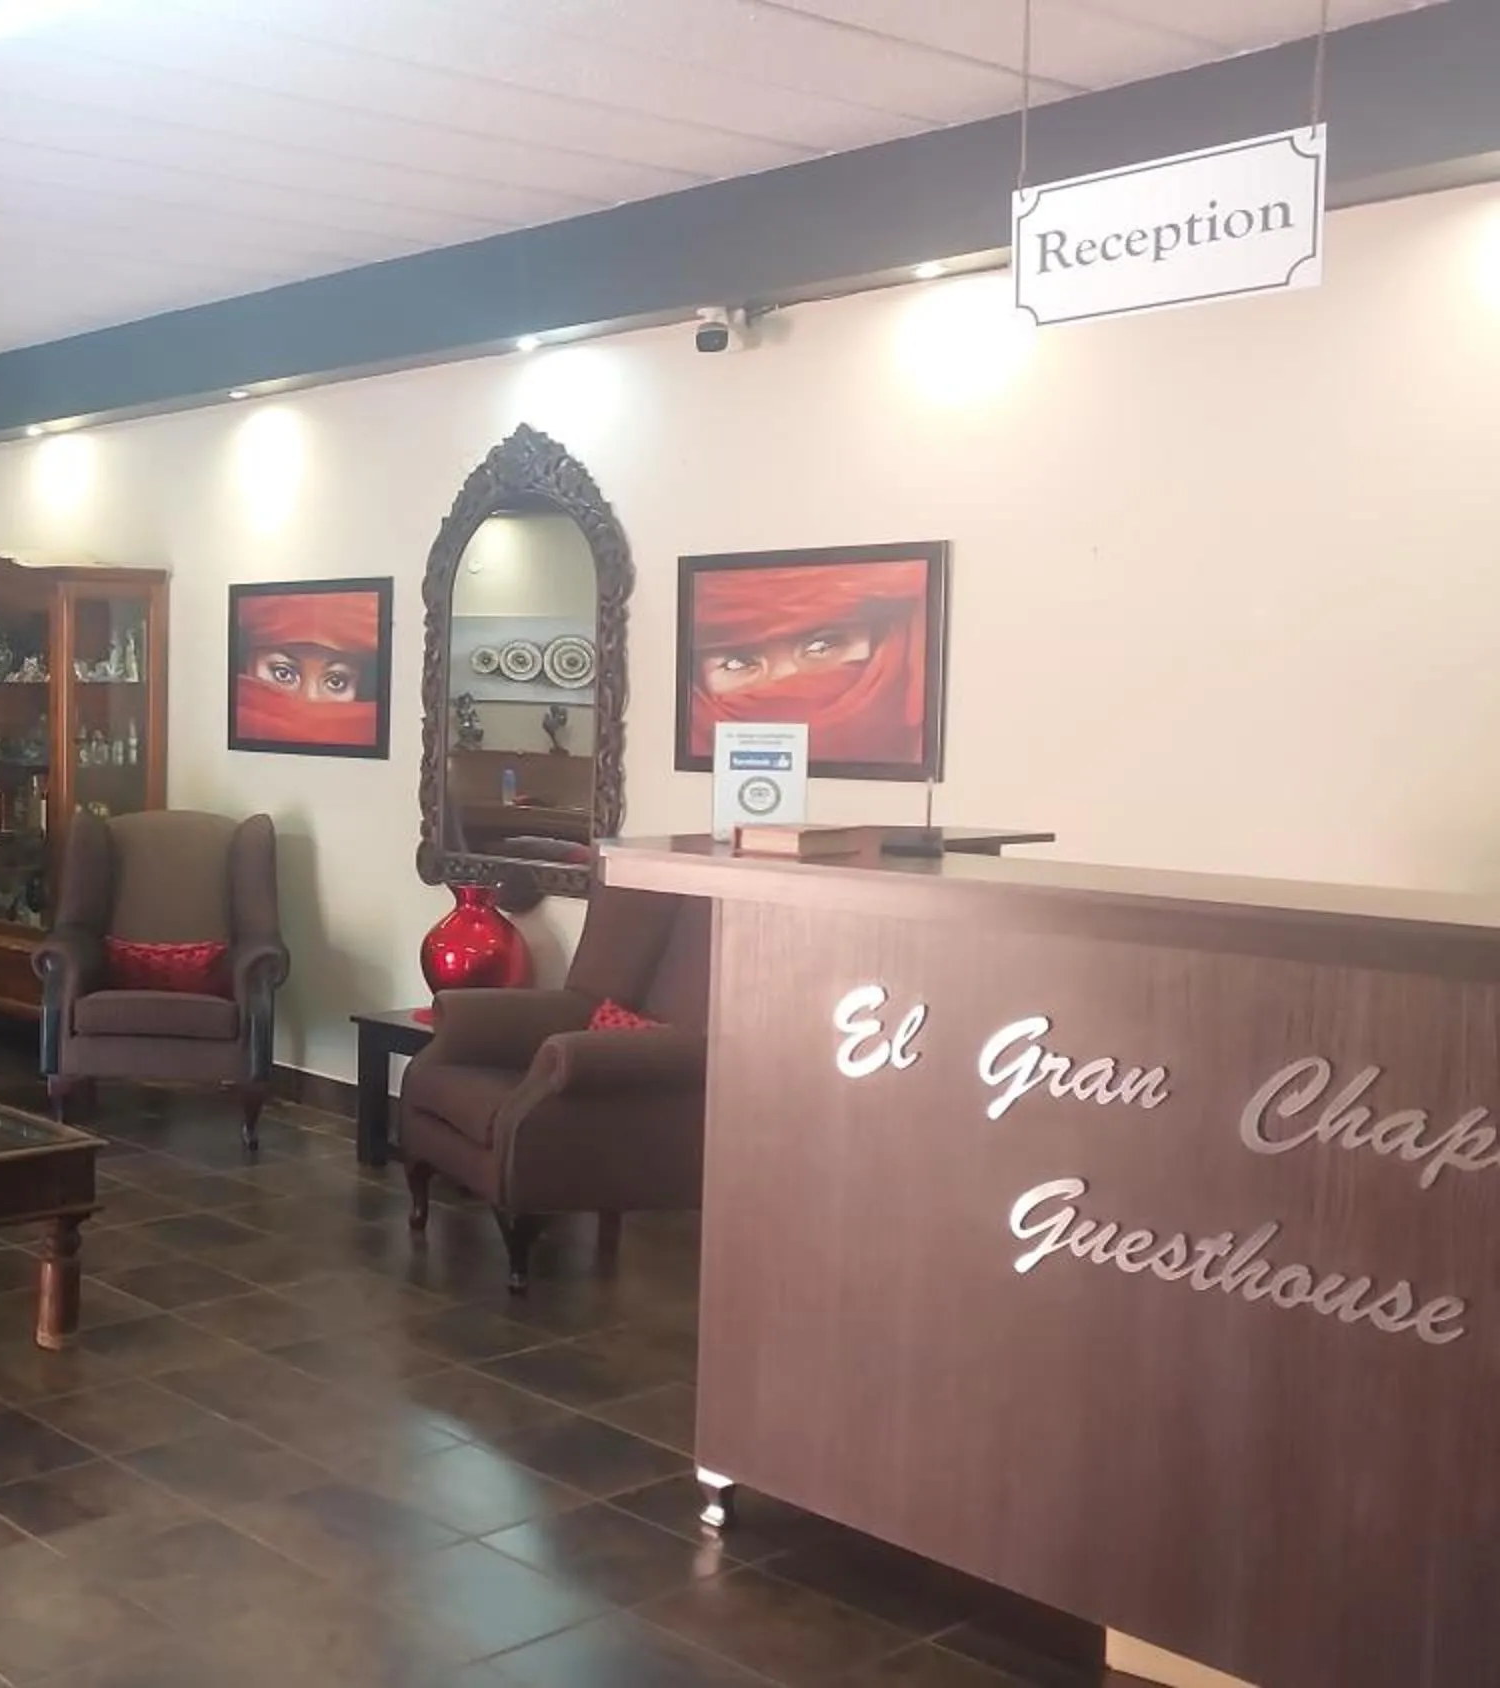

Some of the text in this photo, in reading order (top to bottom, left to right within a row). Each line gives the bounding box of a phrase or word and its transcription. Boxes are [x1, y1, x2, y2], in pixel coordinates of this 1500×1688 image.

[1036, 200, 1294, 274] Reception
[833, 985, 1500, 1189] El Gran Chap
[1009, 1177, 1465, 1344] Guesthouse
